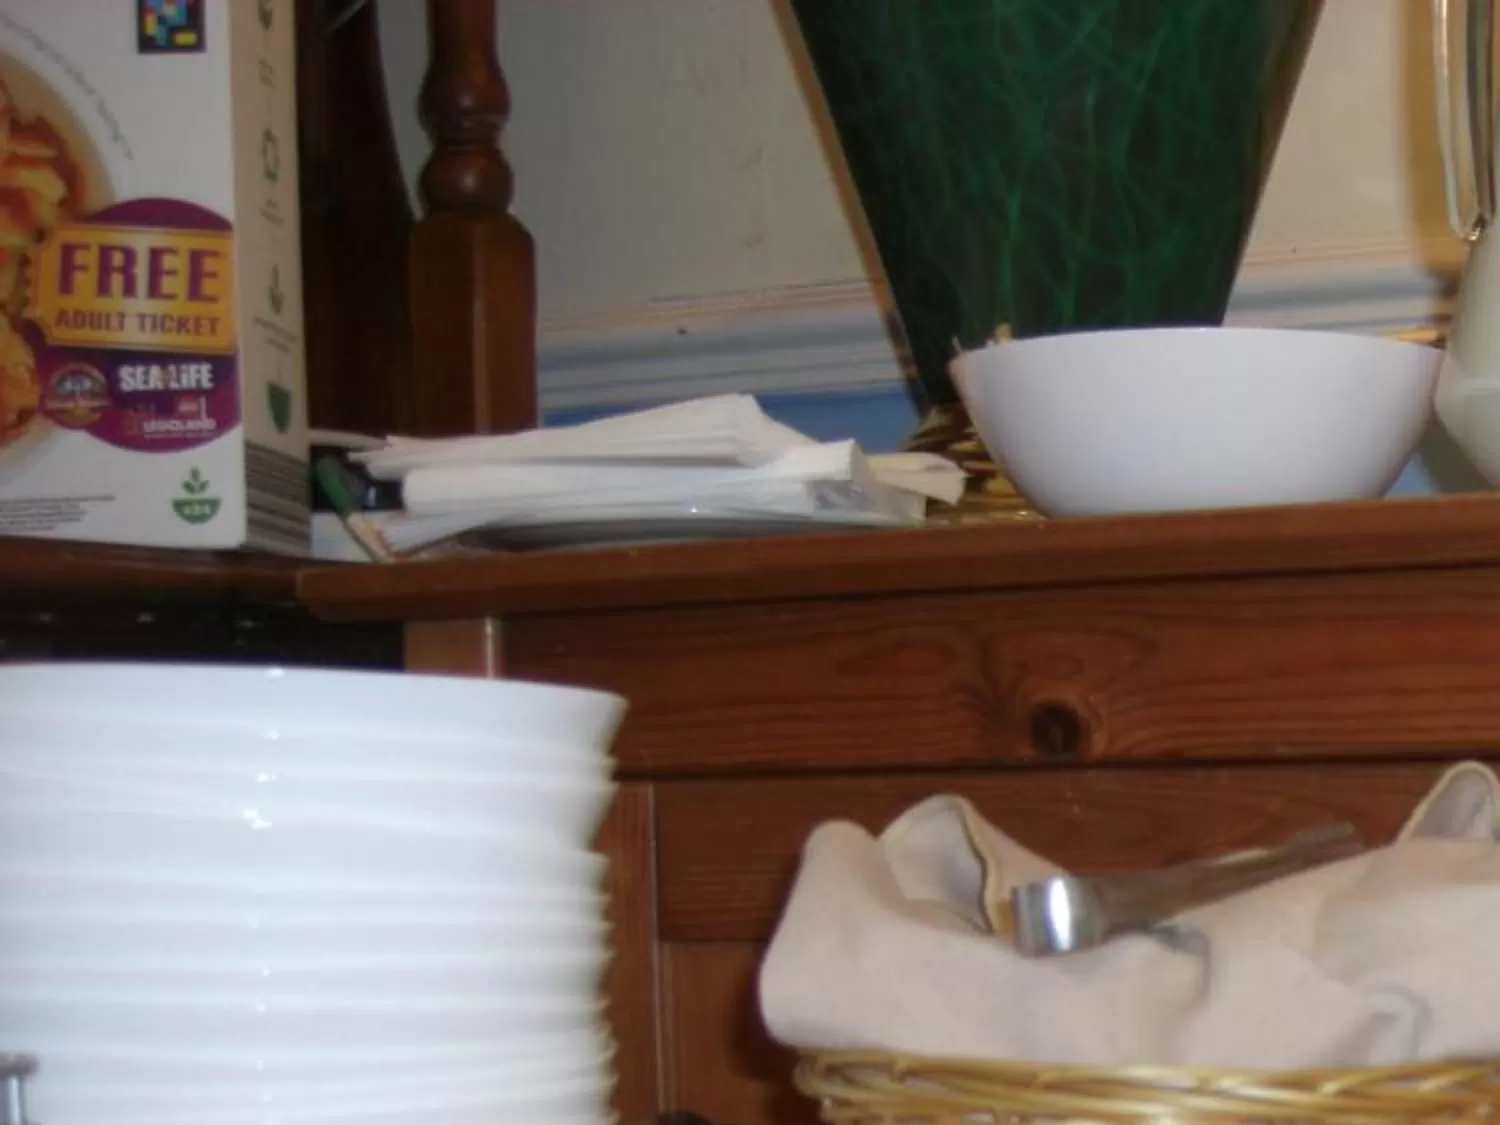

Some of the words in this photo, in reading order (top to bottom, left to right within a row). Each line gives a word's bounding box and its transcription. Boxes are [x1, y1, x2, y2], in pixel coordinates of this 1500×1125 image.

[58, 242, 221, 304] FREE
[55, 309, 126, 332] ADULT
[137, 311, 221, 336] TICKET
[118, 364, 165, 392] SEA
